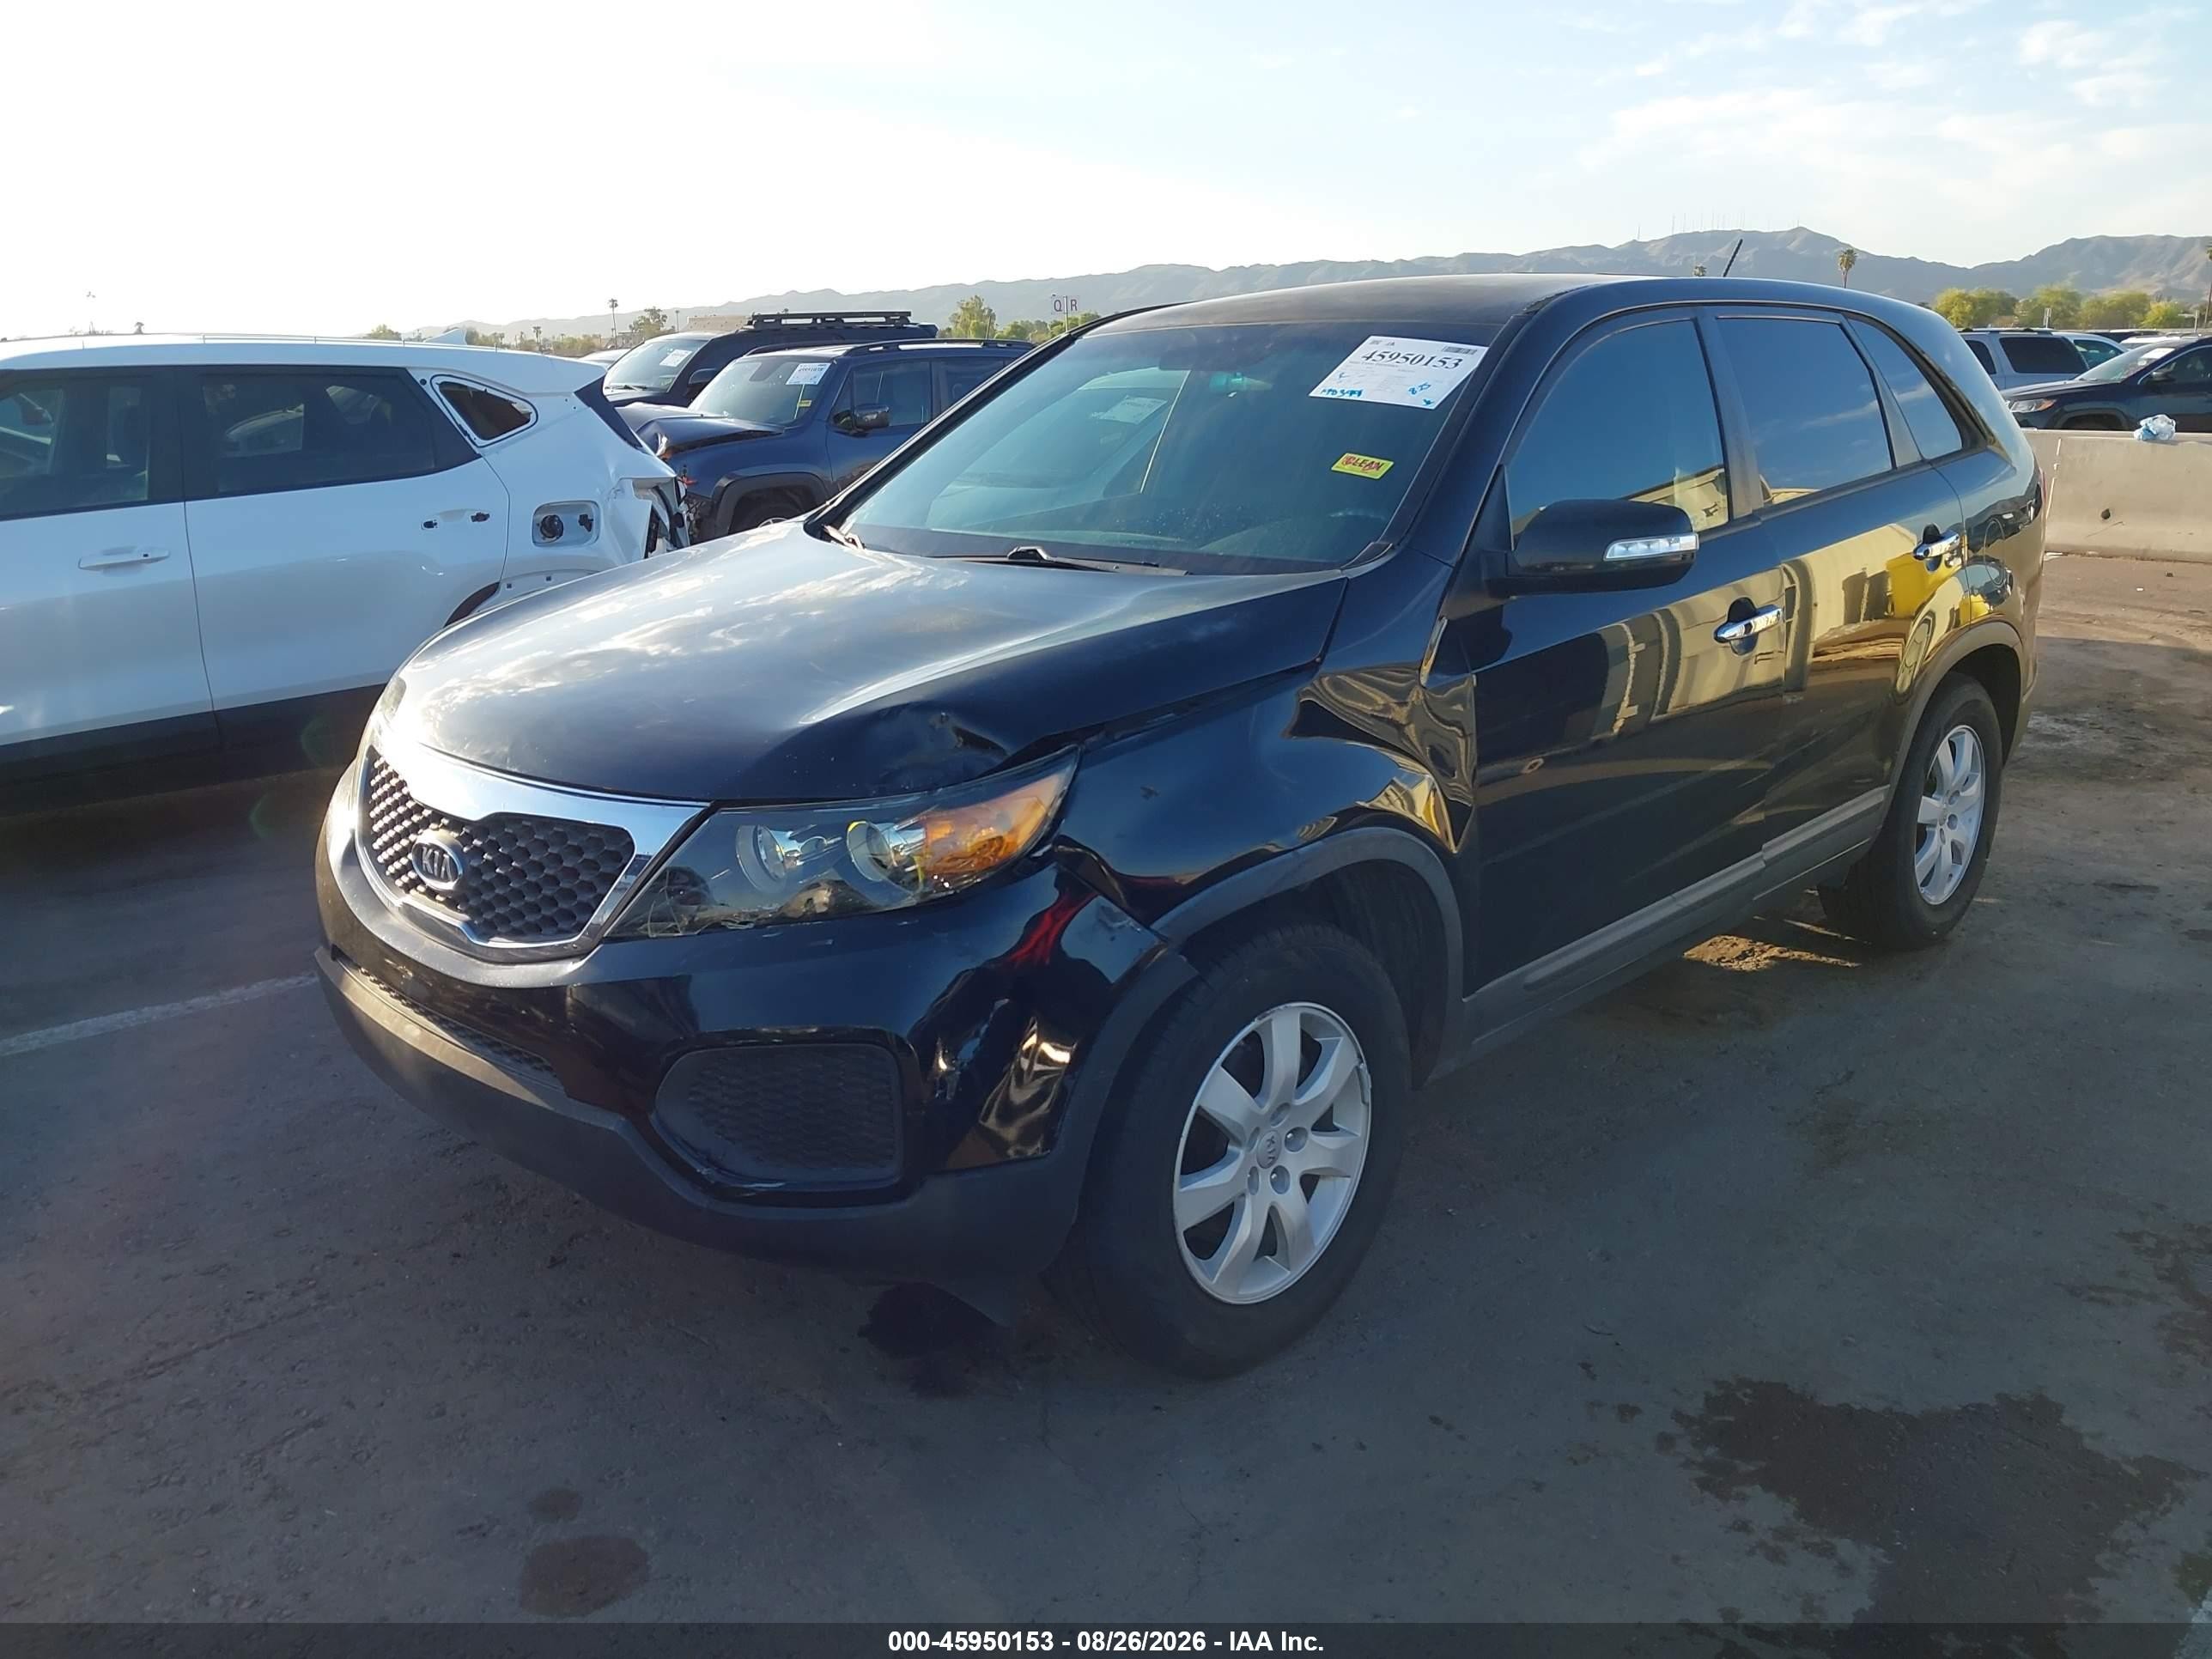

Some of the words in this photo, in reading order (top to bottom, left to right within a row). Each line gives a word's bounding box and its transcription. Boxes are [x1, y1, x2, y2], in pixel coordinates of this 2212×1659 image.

[1054, 299, 1062, 312] Q
[1070, 299, 1078, 311] R
[1361, 350, 1463, 369] 45950153
[422, 846, 453, 883] KIA
